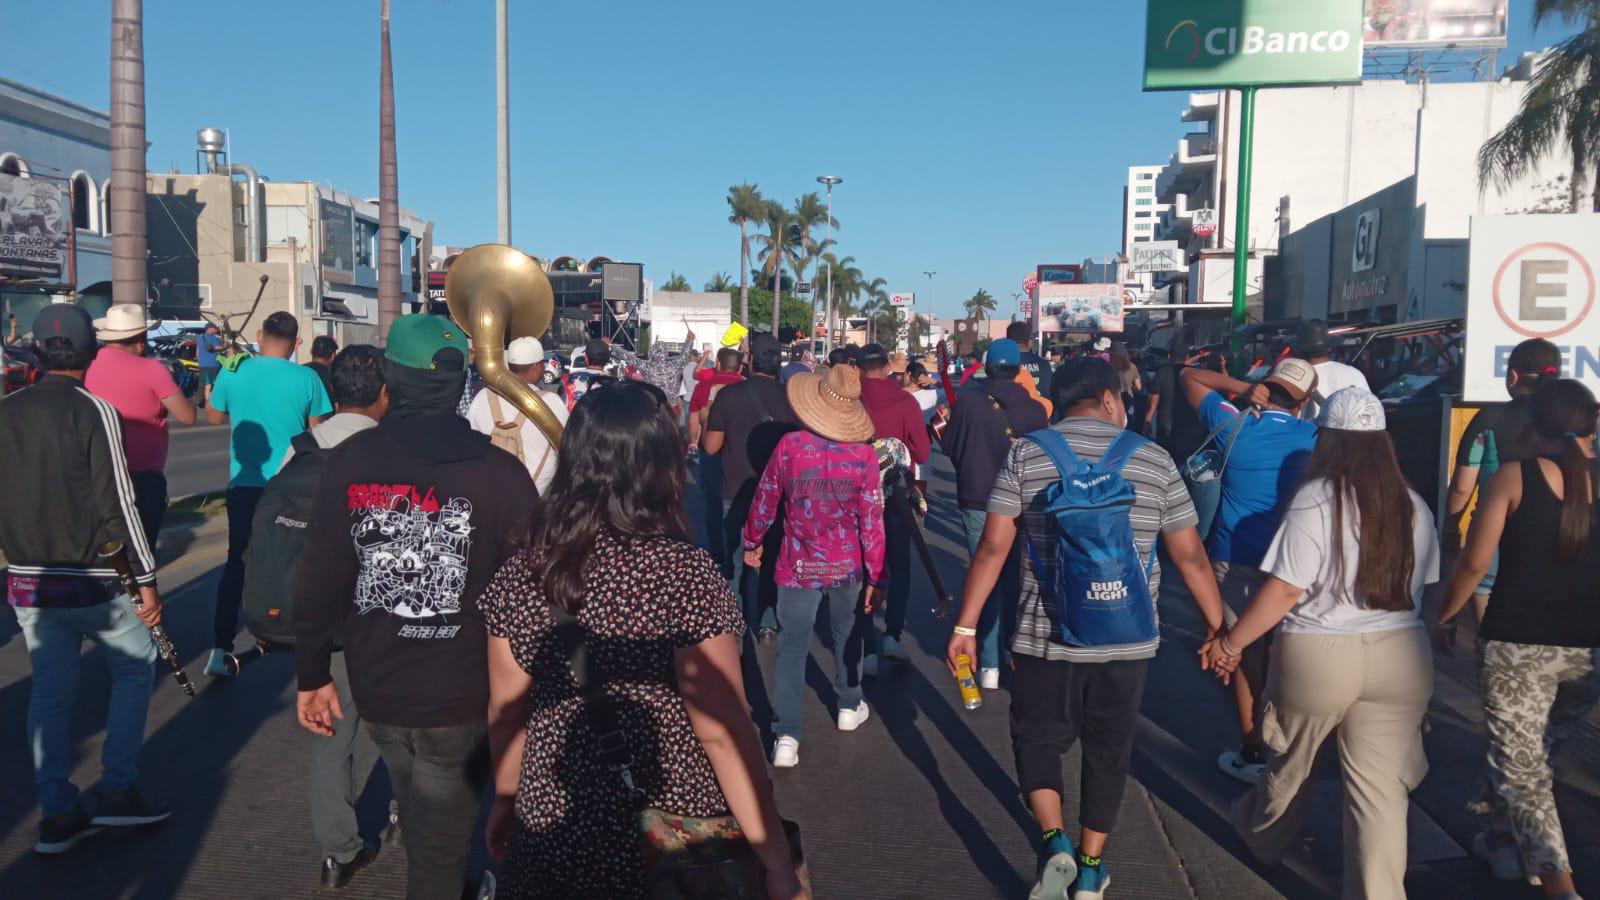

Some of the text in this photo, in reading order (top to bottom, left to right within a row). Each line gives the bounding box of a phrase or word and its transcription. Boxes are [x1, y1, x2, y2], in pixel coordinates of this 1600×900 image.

[0, 246, 57, 259] ONTANAS
[1519, 259, 1568, 321] E
[1088, 474, 1111, 486] LIGHT
[1086, 585, 1128, 600] LIGHT
[1091, 580, 1123, 592] BUD
